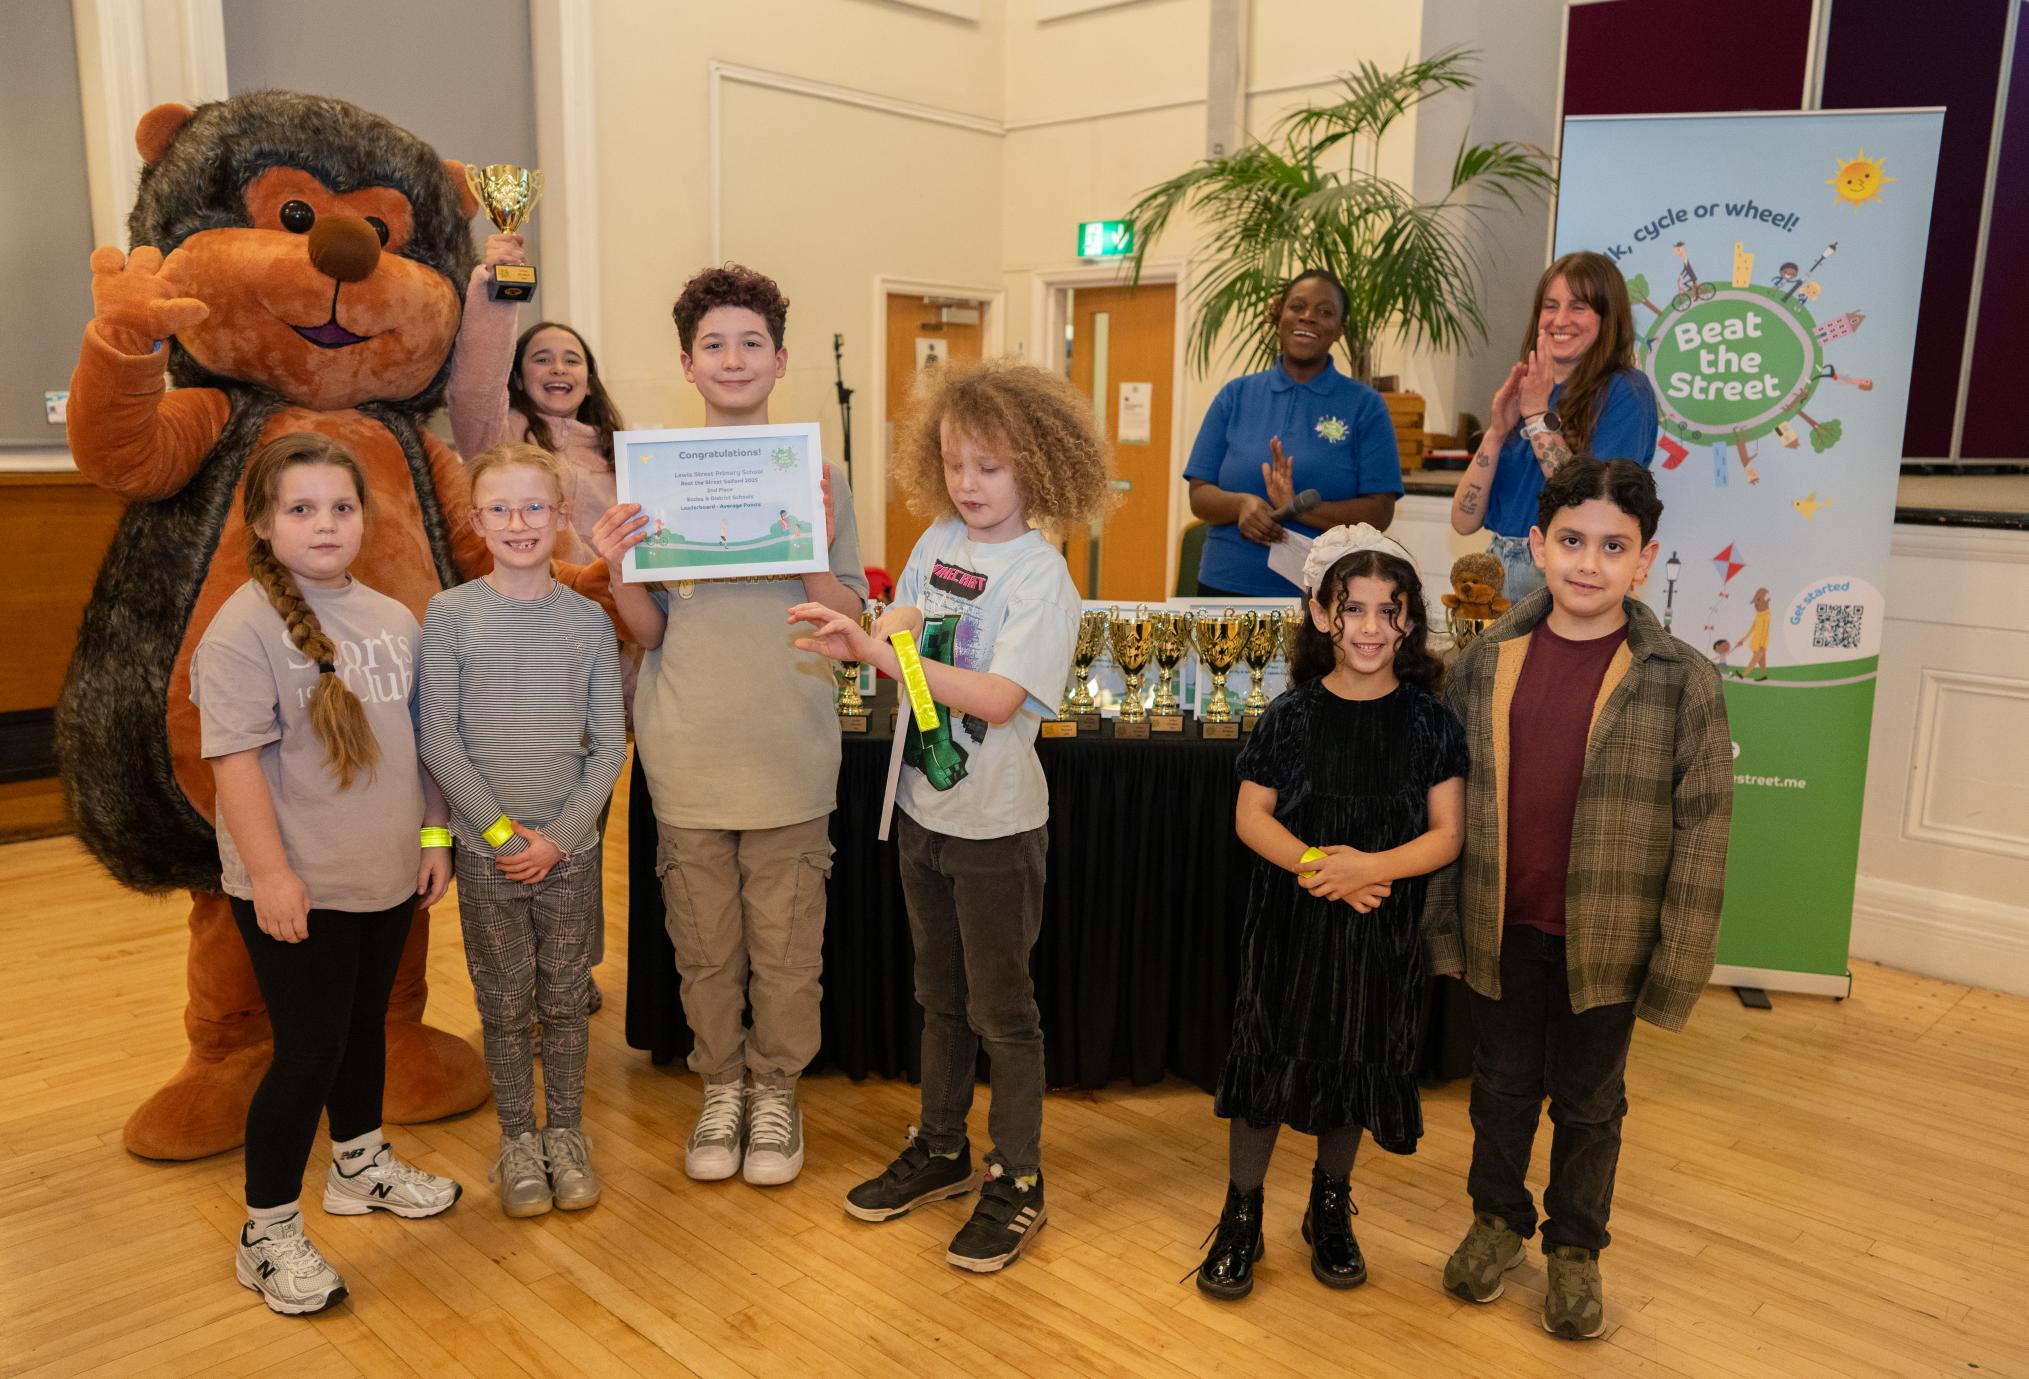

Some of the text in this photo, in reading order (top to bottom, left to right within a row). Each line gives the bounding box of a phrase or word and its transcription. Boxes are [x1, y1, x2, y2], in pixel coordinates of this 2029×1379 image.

[1633, 207, 1688, 243] cycle
[1693, 203, 1720, 219] or
[1725, 199, 1800, 233] wheel!
[1674, 311, 1763, 352] Beat
[1699, 344, 1762, 375] the
[1667, 371, 1781, 401] Street
[679, 447, 761, 460] Congratulations!
[1789, 580, 1850, 625] Get started
[281, 627, 413, 670] Sorts
[368, 1182, 393, 1199] N
[256, 1258, 277, 1281] N
